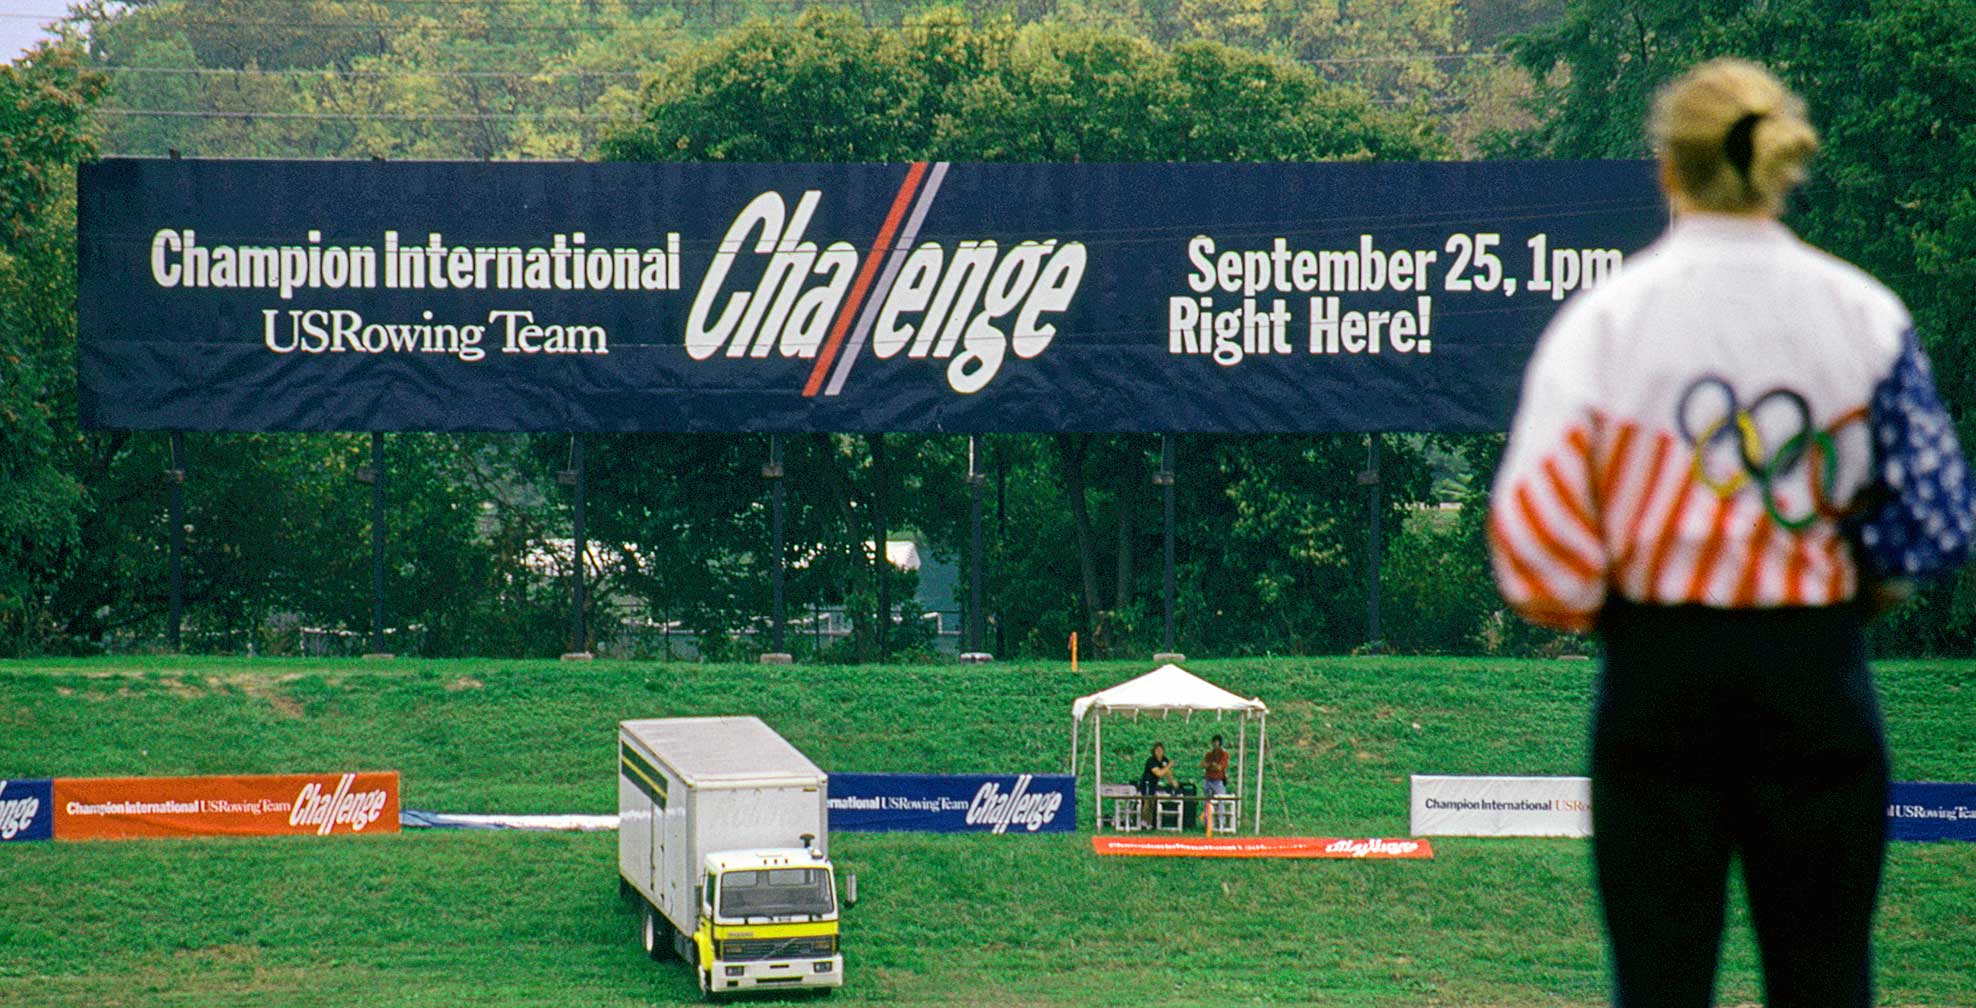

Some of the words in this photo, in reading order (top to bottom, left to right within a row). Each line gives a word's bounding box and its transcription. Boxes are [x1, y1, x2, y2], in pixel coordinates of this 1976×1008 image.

[151, 228, 377, 299] Champion
[384, 230, 681, 290] International
[1187, 234, 1437, 297] September
[1444, 233, 1517, 298] 25,
[1526, 233, 1624, 301] 1pm
[262, 309, 487, 361] USRowing
[489, 309, 609, 355] Team
[1169, 295, 1293, 367] Right
[1308, 295, 1433, 354] Here!
[66, 801, 125, 816] Champion
[125, 800, 199, 814] International
[200, 800, 261, 815] USRowing
[259, 798, 291, 812] Team
[289, 773, 387, 836] Challenge
[827, 796, 880, 809] rnational
[881, 796, 941, 812] USRowing
[937, 797, 969, 810] Team
[965, 774, 1063, 834] Challenge
[1425, 798, 1480, 812] Champion
[1481, 800, 1552, 811] International
[1895, 804, 1957, 821] USRowing
[1954, 805, 1976, 819] Tea
